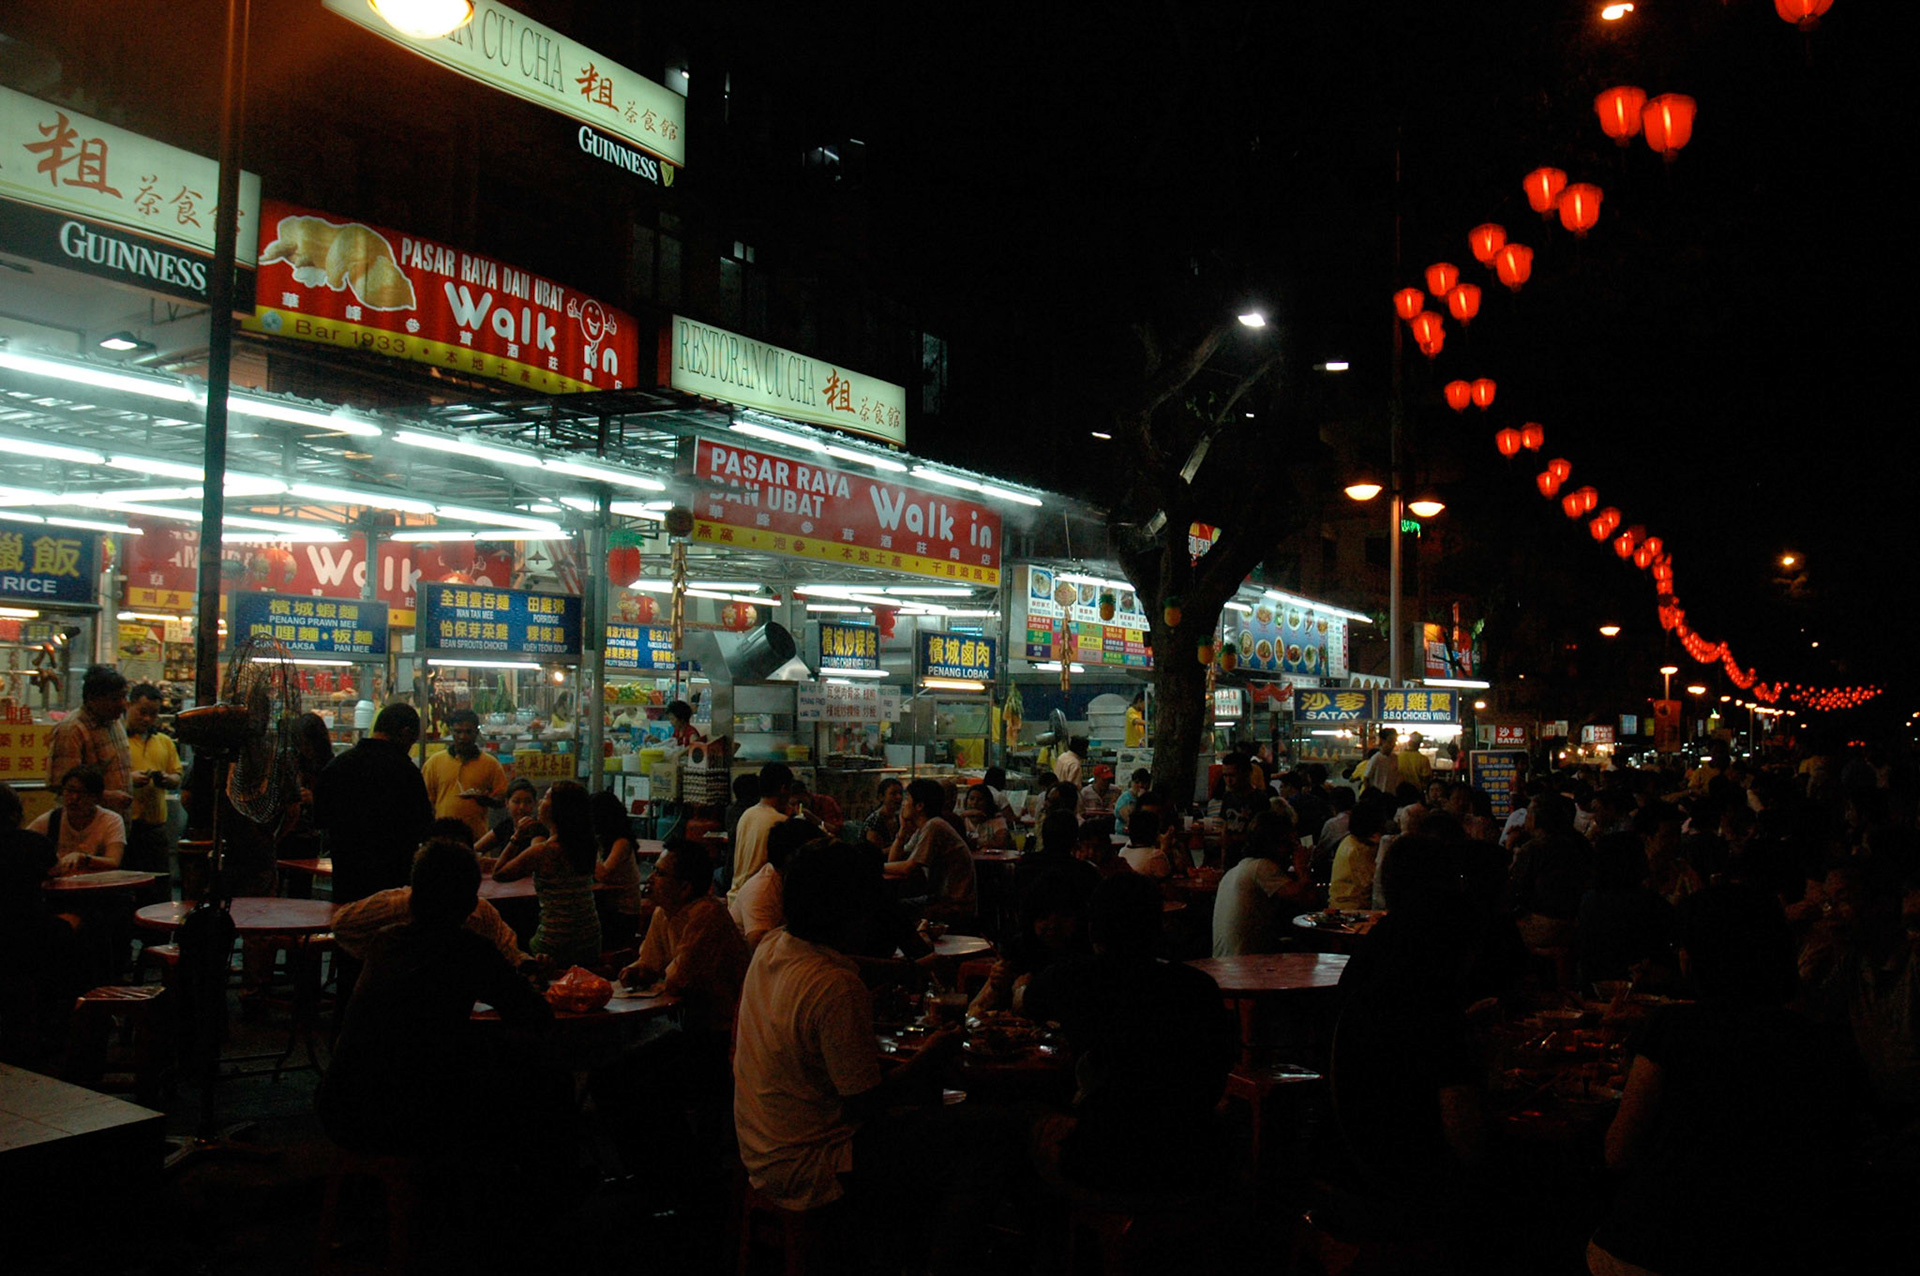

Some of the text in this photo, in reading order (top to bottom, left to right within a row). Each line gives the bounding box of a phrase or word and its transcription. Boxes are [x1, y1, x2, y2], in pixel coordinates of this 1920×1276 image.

[482, 8, 515, 67] CU
[519, 27, 565, 93] CHA
[575, 61, 619, 114] 粗
[22, 110, 124, 200] 粗
[577, 125, 658, 182] GUINNESS
[59, 220, 207, 292] GUINNESS
[401, 236, 565, 313] PASAR RAYA DAN UBAT
[296, 319, 340, 341] Bar
[351, 330, 406, 354] 1933
[444, 281, 557, 353] Walk
[679, 320, 816, 407] RESTORAN CU CHA
[822, 368, 856, 414] 粗
[709, 474, 825, 519] DAN UBAT
[711, 446, 851, 500] PASAR RAYA
[869, 484, 992, 549] Walk in
[3, 576, 57, 594] RICE
[269, 614, 358, 629] PENANG PRAWN MEE
[456, 608, 470, 617] WAN
[471, 610, 482, 618] TAN
[482, 611, 494, 620] MEE
[286, 641, 316, 651] LAKSA
[333, 643, 350, 652] PAN
[352, 645, 370, 653] MEE
[440, 638, 457, 649] BEAN
[457, 639, 483, 650] SPROUTS
[484, 641, 509, 651] CHICKEN
[927, 665, 989, 680] PENANG LOBAK
[1306, 711, 1360, 720] SATAY
[1403, 711, 1432, 721] CHICKEN
[1432, 711, 1451, 721] WING
